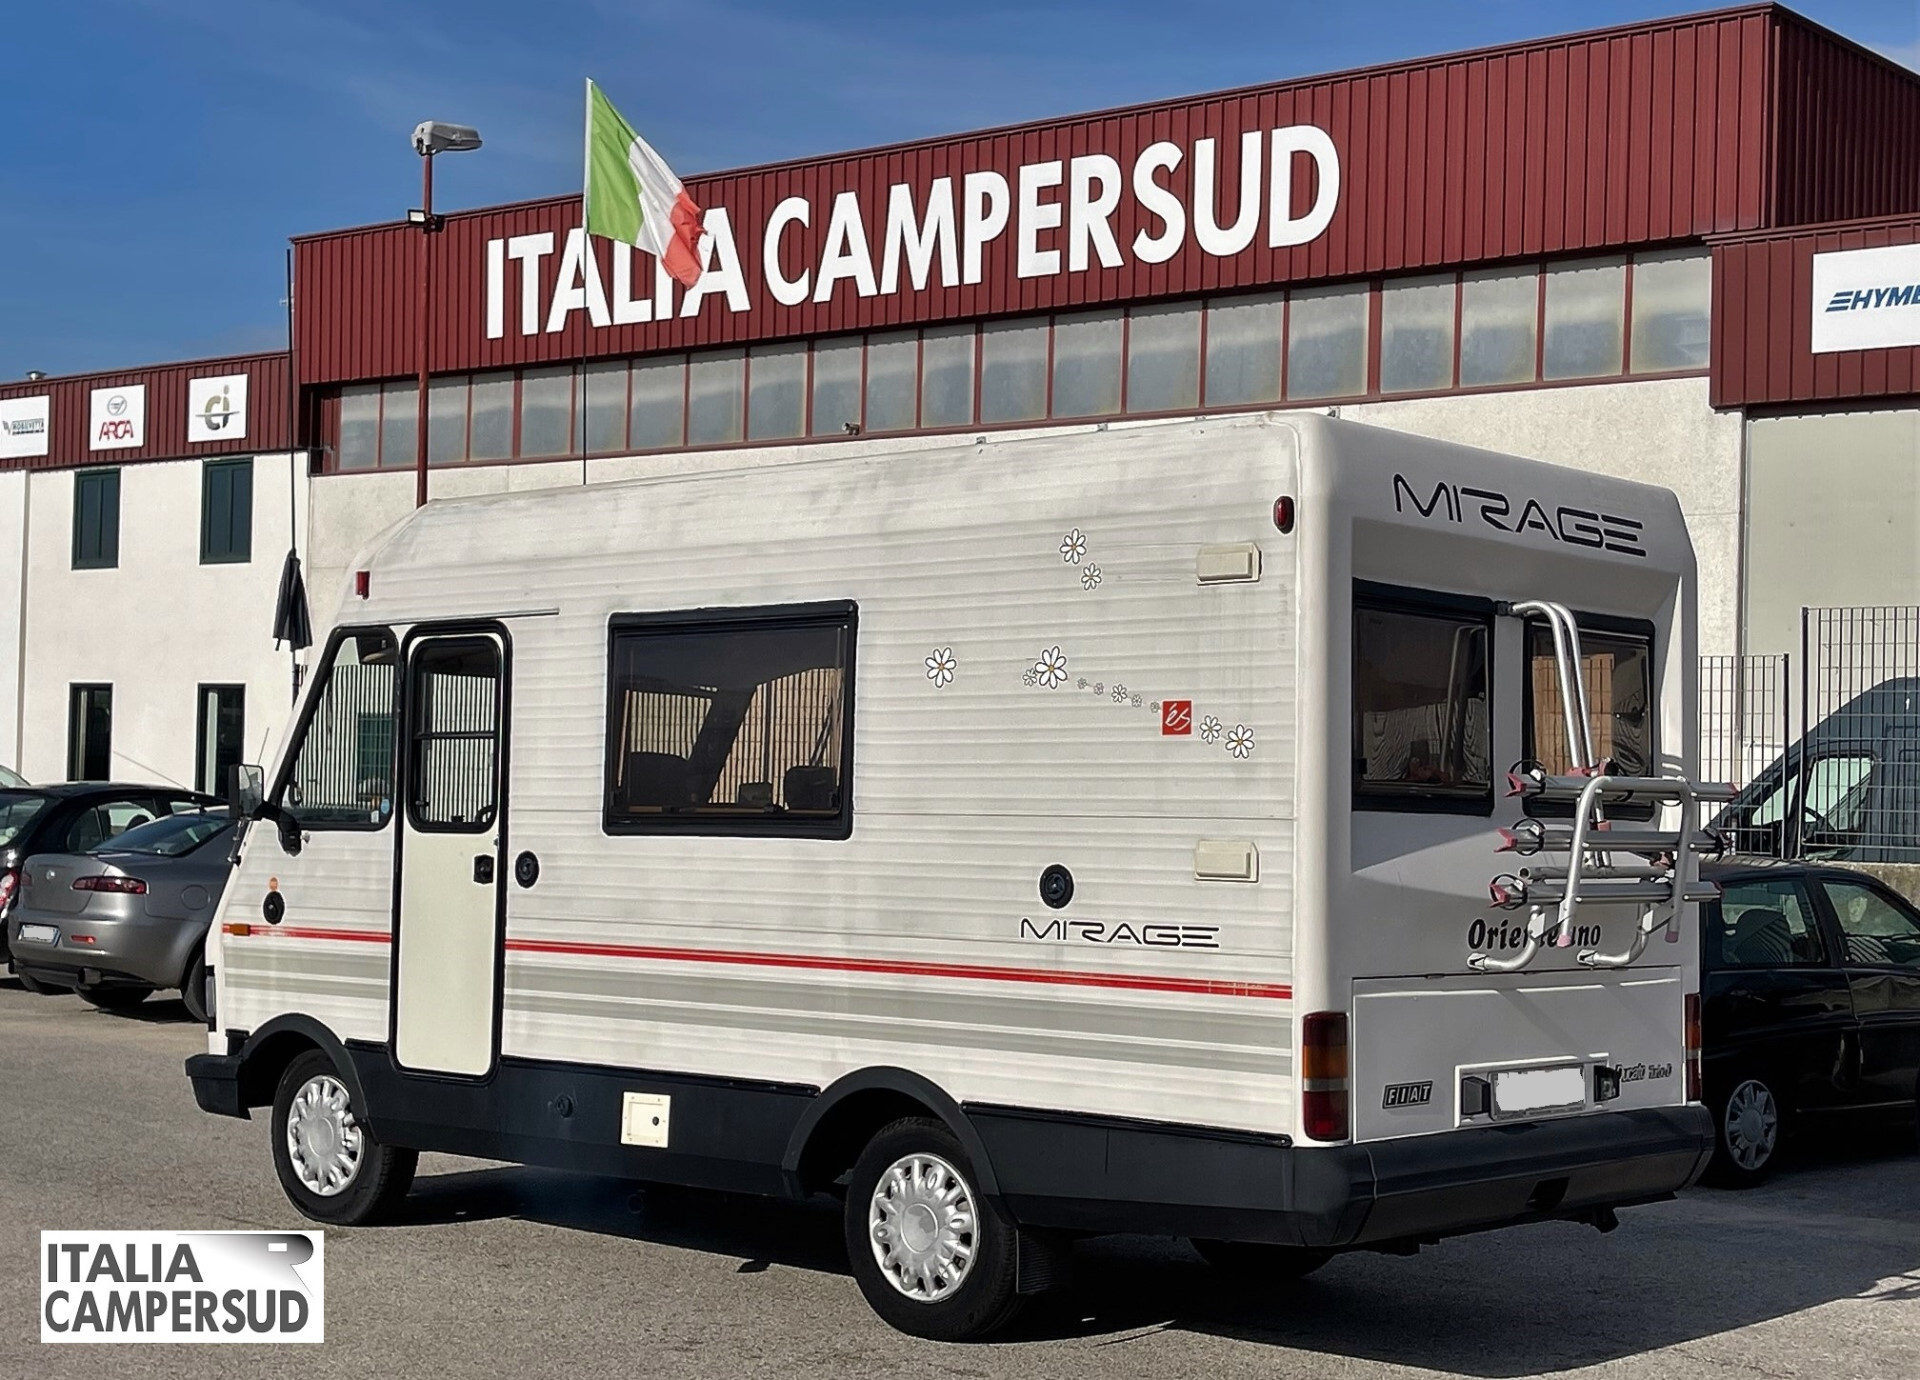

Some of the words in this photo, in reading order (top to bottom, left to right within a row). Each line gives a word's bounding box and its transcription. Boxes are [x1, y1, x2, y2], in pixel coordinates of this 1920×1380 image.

[482, 206, 752, 340] ITALIA
[763, 124, 1341, 306] CAMPERSUD
[99, 419, 134, 442] ARCA
[1393, 473, 1647, 557] MIRAGE
[1020, 917, 1220, 949] MIRAGE
[1387, 1085, 1431, 1104] FIAT
